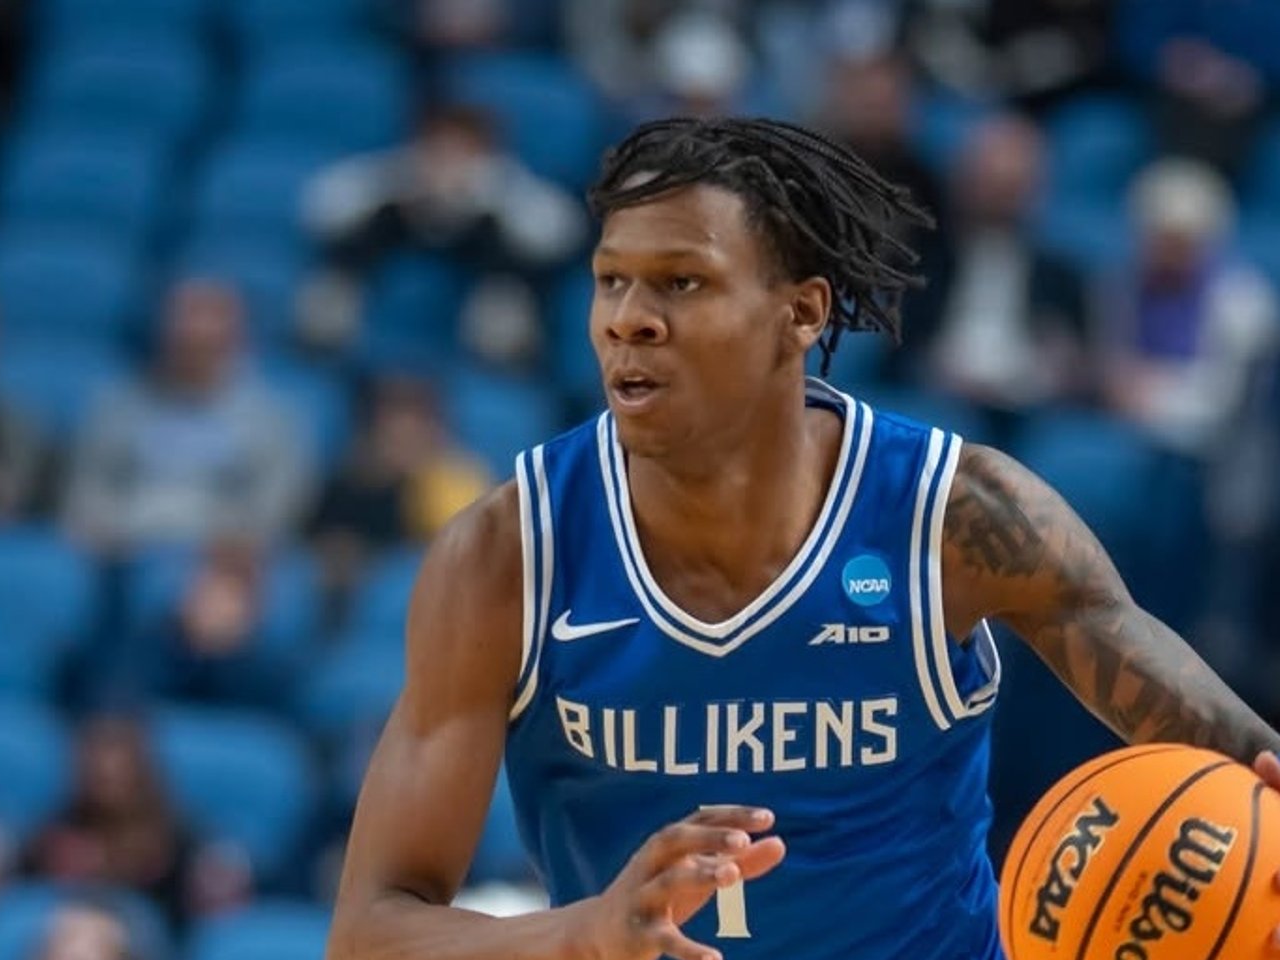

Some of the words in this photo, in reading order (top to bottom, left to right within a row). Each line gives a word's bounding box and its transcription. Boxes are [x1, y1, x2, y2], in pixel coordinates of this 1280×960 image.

[849, 578, 890, 594] NCAA
[807, 623, 890, 646] A10
[556, 695, 898, 776] BILLIKENS
[1029, 796, 1119, 943] NCAA
